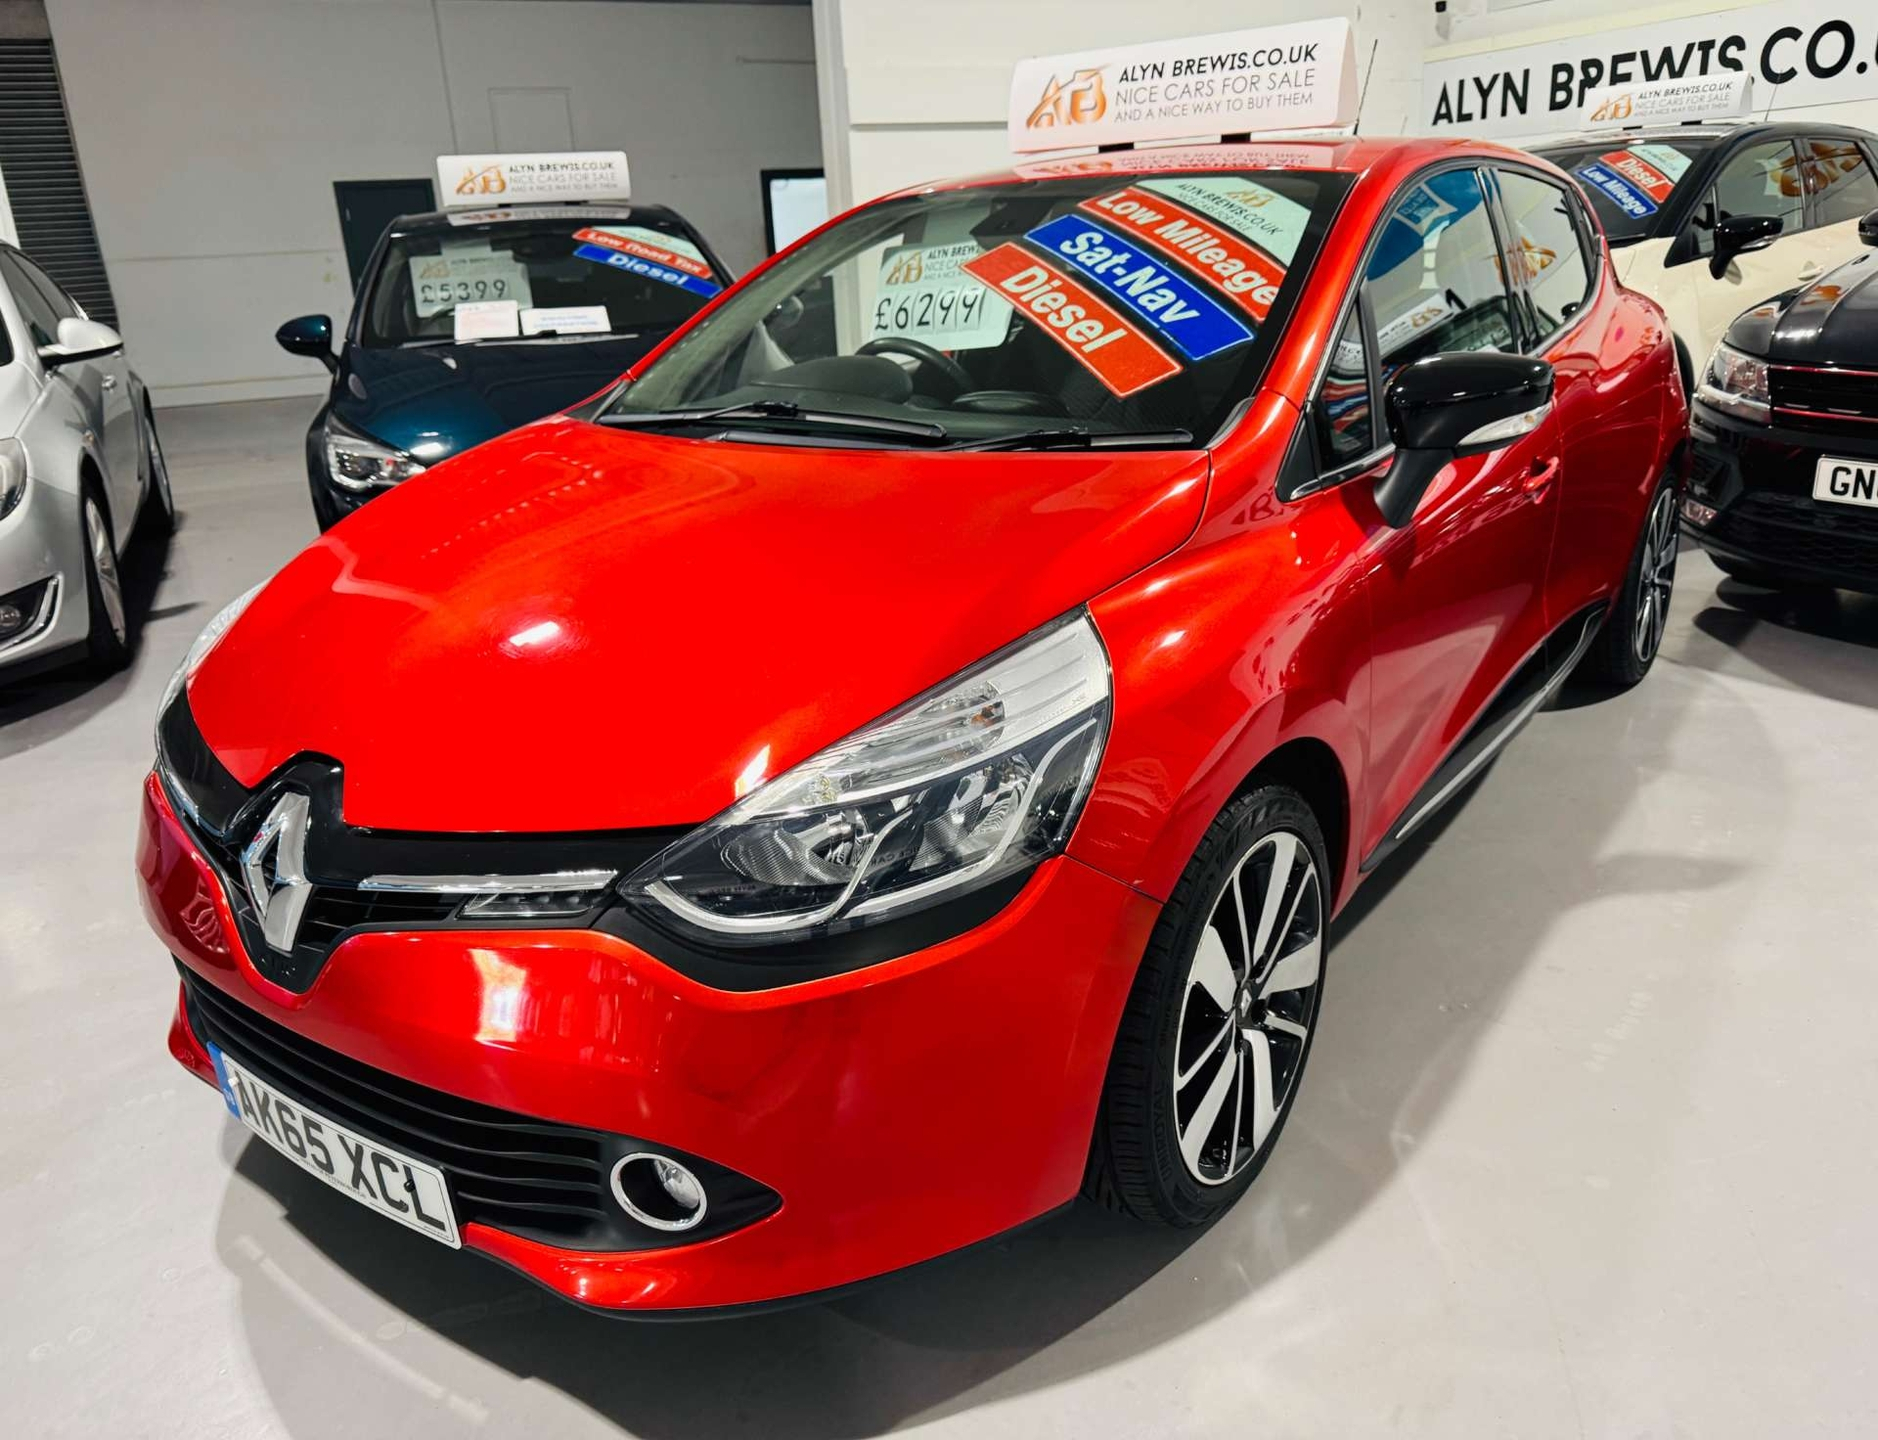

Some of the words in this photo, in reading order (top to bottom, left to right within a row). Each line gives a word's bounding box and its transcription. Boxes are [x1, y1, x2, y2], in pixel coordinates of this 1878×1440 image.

[1119, 62, 1164, 84] ALYN
[1172, 43, 1318, 78] BREWIS.CO.UK
[1432, 68, 1530, 126] ALYN
[1548, 19, 1878, 113] BREWIS.CO.
[1115, 85, 1159, 107] NICE
[1164, 79, 1215, 102] CARS
[1222, 74, 1260, 96] FOR
[1267, 68, 1316, 89] SALE
[1636, 100, 1657, 110] NICE
[1658, 97, 1684, 108] CARS
[1685, 95, 1705, 106] FOR
[1707, 92, 1730, 102] SALE
[1638, 91, 1660, 100] ALYN
[1664, 81, 1733, 97] BREWIS.CO.UK
[1114, 109, 1142, 123] AND
[1145, 108, 1155, 120] A
[1158, 104, 1189, 119] NICE
[1192, 101, 1222, 116] WAY
[1226, 98, 1246, 112] TO
[1248, 95, 1274, 110] BUY
[1277, 92, 1313, 107] THEM
[509, 164, 535, 173] ALYN
[539, 162, 614, 173] BREWIS.CO.UK
[509, 175, 535, 185] NICE
[537, 174, 567, 184] CARS
[569, 173, 588, 183] FOR
[592, 172, 618, 182] SALE
[1616, 158, 1666, 189] Diesel
[1177, 183, 1206, 196] ALYN
[1582, 167, 1610, 183] Low
[1602, 180, 1647, 214] Mileage
[586, 230, 624, 247] Low
[674, 255, 702, 273] Tax
[928, 247, 949, 260] ALYN
[1095, 190, 1161, 227] Low
[1152, 220, 1281, 306] Mileage
[607, 253, 689, 285] Diesel
[924, 260, 946, 271] NICE
[1059, 230, 1200, 325] Sat-Nav
[421, 279, 506, 303] £5399
[875, 287, 979, 330] £6299
[999, 266, 1128, 354] Diesel
[1830, 466, 1878, 501] GN
[234, 1070, 334, 1175] AK65
[338, 1134, 446, 1232] XCL
